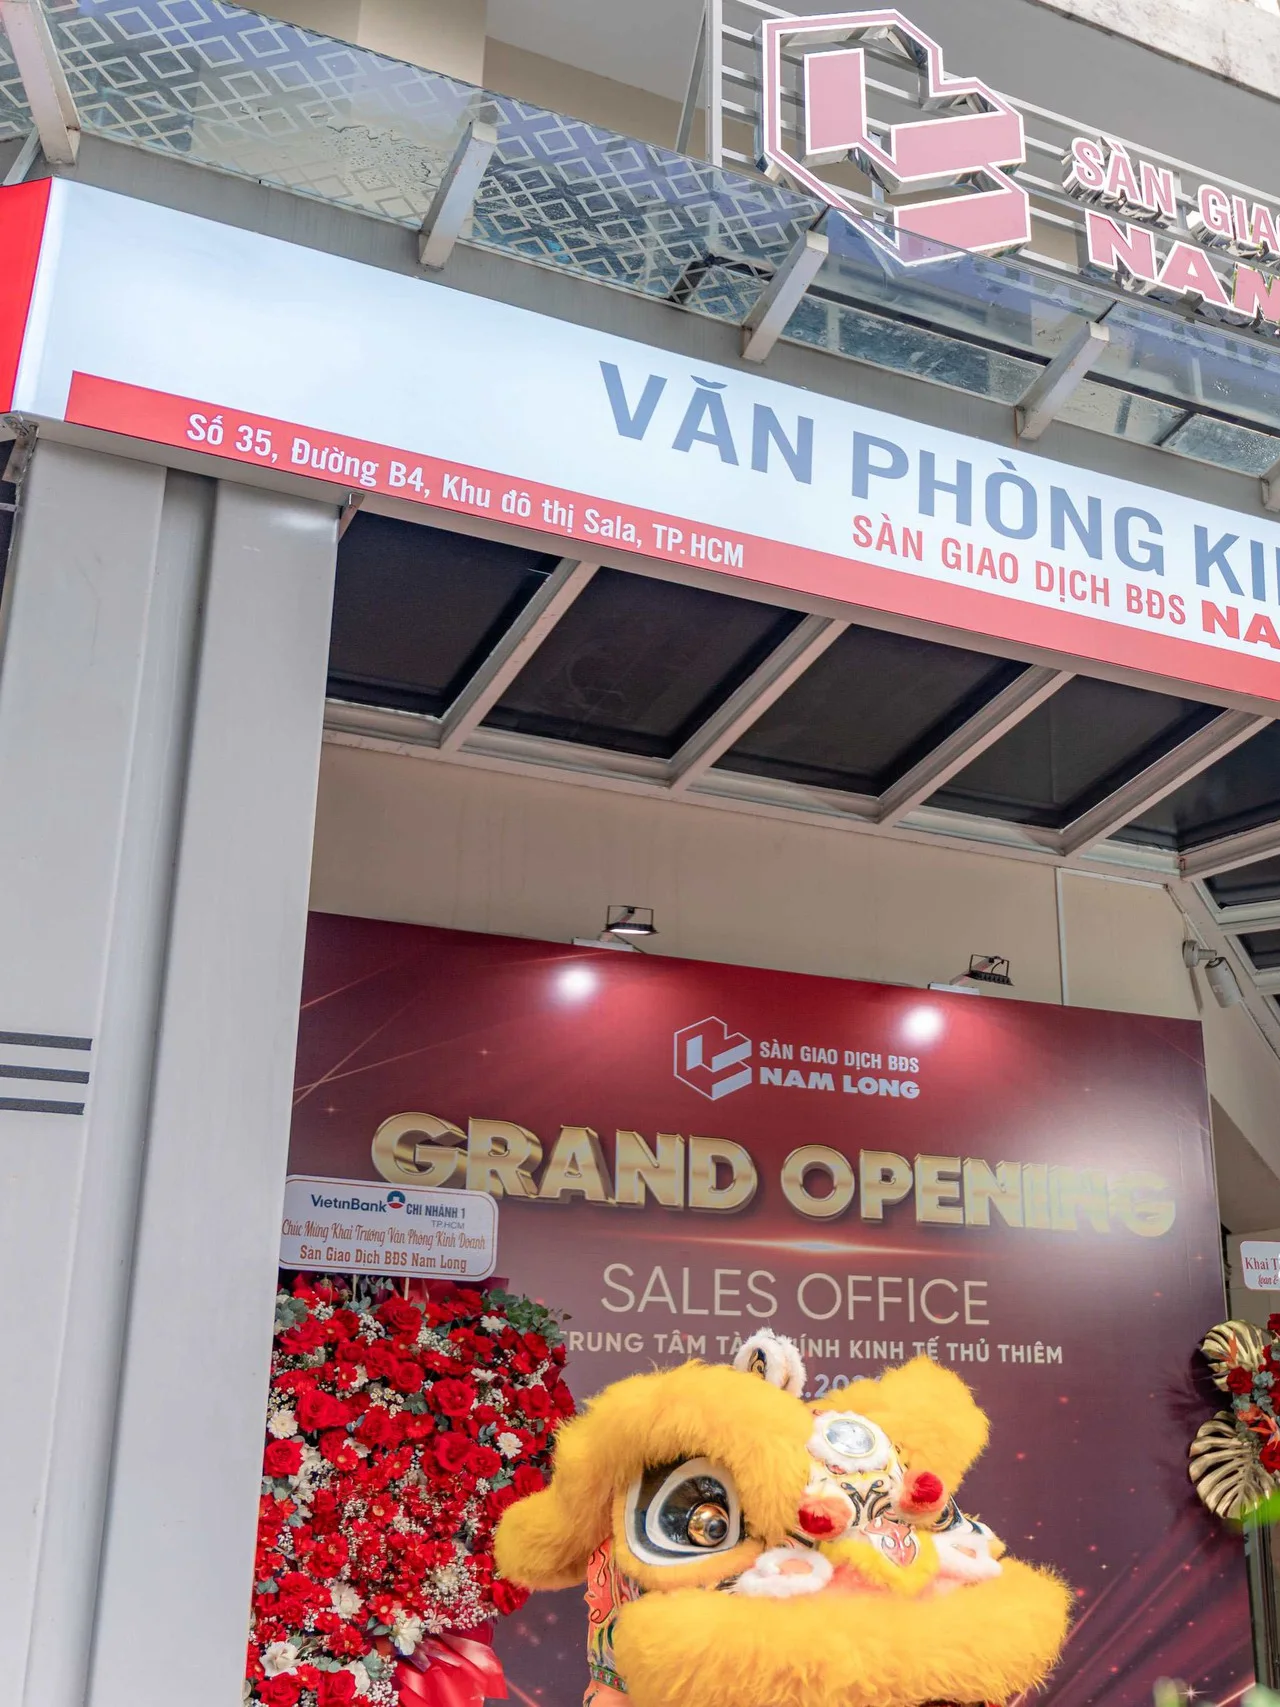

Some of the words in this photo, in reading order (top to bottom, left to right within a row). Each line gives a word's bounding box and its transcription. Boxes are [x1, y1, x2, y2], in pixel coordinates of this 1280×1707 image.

[1069, 137, 1176, 219] SÀN
[599, 360, 814, 485] VĂN
[851, 431, 1165, 577] PHÒNG
[186, 413, 224, 446] Số
[235, 425, 278, 464] 35,
[291, 437, 380, 487] Đường
[388, 460, 431, 499] B4,
[442, 473, 491, 508] Khu
[501, 489, 531, 518] đô
[542, 499, 574, 534] thị
[583, 508, 643, 549] Sala,
[652, 523, 745, 569] TP.HCM
[851, 513, 924, 562] SÀN
[941, 537, 1019, 585] GIAO
[1034, 561, 1111, 606] DỊCH
[1125, 580, 1186, 626] BĐS
[759, 1038, 793, 1060] SÀN
[800, 1045, 839, 1065] GIAO
[844, 1050, 882, 1071] DỊCH
[888, 1055, 920, 1074] BĐS
[759, 1066, 835, 1092] NAM
[843, 1075, 921, 1099] LONG
[371, 1111, 760, 1213] GRAND
[780, 1143, 1177, 1238] OPENING
[311, 1194, 387, 1213] VietinBank
[406, 1203, 422, 1216] CHI
[424, 1203, 458, 1218] NHÁNH
[460, 1207, 466, 1219] 1
[281, 1218, 303, 1237] Chúc
[331, 1222, 354, 1240] Khai
[435, 1230, 456, 1248] Kinh
[458, 1232, 486, 1250] Doanh
[431, 1219, 465, 1230] TP.HCM
[299, 1244, 322, 1260] Sàn
[326, 1246, 351, 1262] Giao
[354, 1248, 380, 1267] Dịch
[384, 1250, 408, 1266] BĐS
[411, 1252, 436, 1268] Nam
[440, 1254, 467, 1273] Long
[1244, 1257, 1269, 1270] Khai
[600, 1262, 778, 1319] SALES
[796, 1271, 990, 1326] OFFICE
[653, 1329, 707, 1355] TÂM
[715, 1331, 745, 1355] TÀ
[792, 1333, 840, 1358] ÍNH
[849, 1339, 904, 1360] KINH
[912, 1335, 941, 1361] TẾ
[946, 1337, 990, 1362] THỦ
[997, 1340, 1064, 1364] THIÊM
